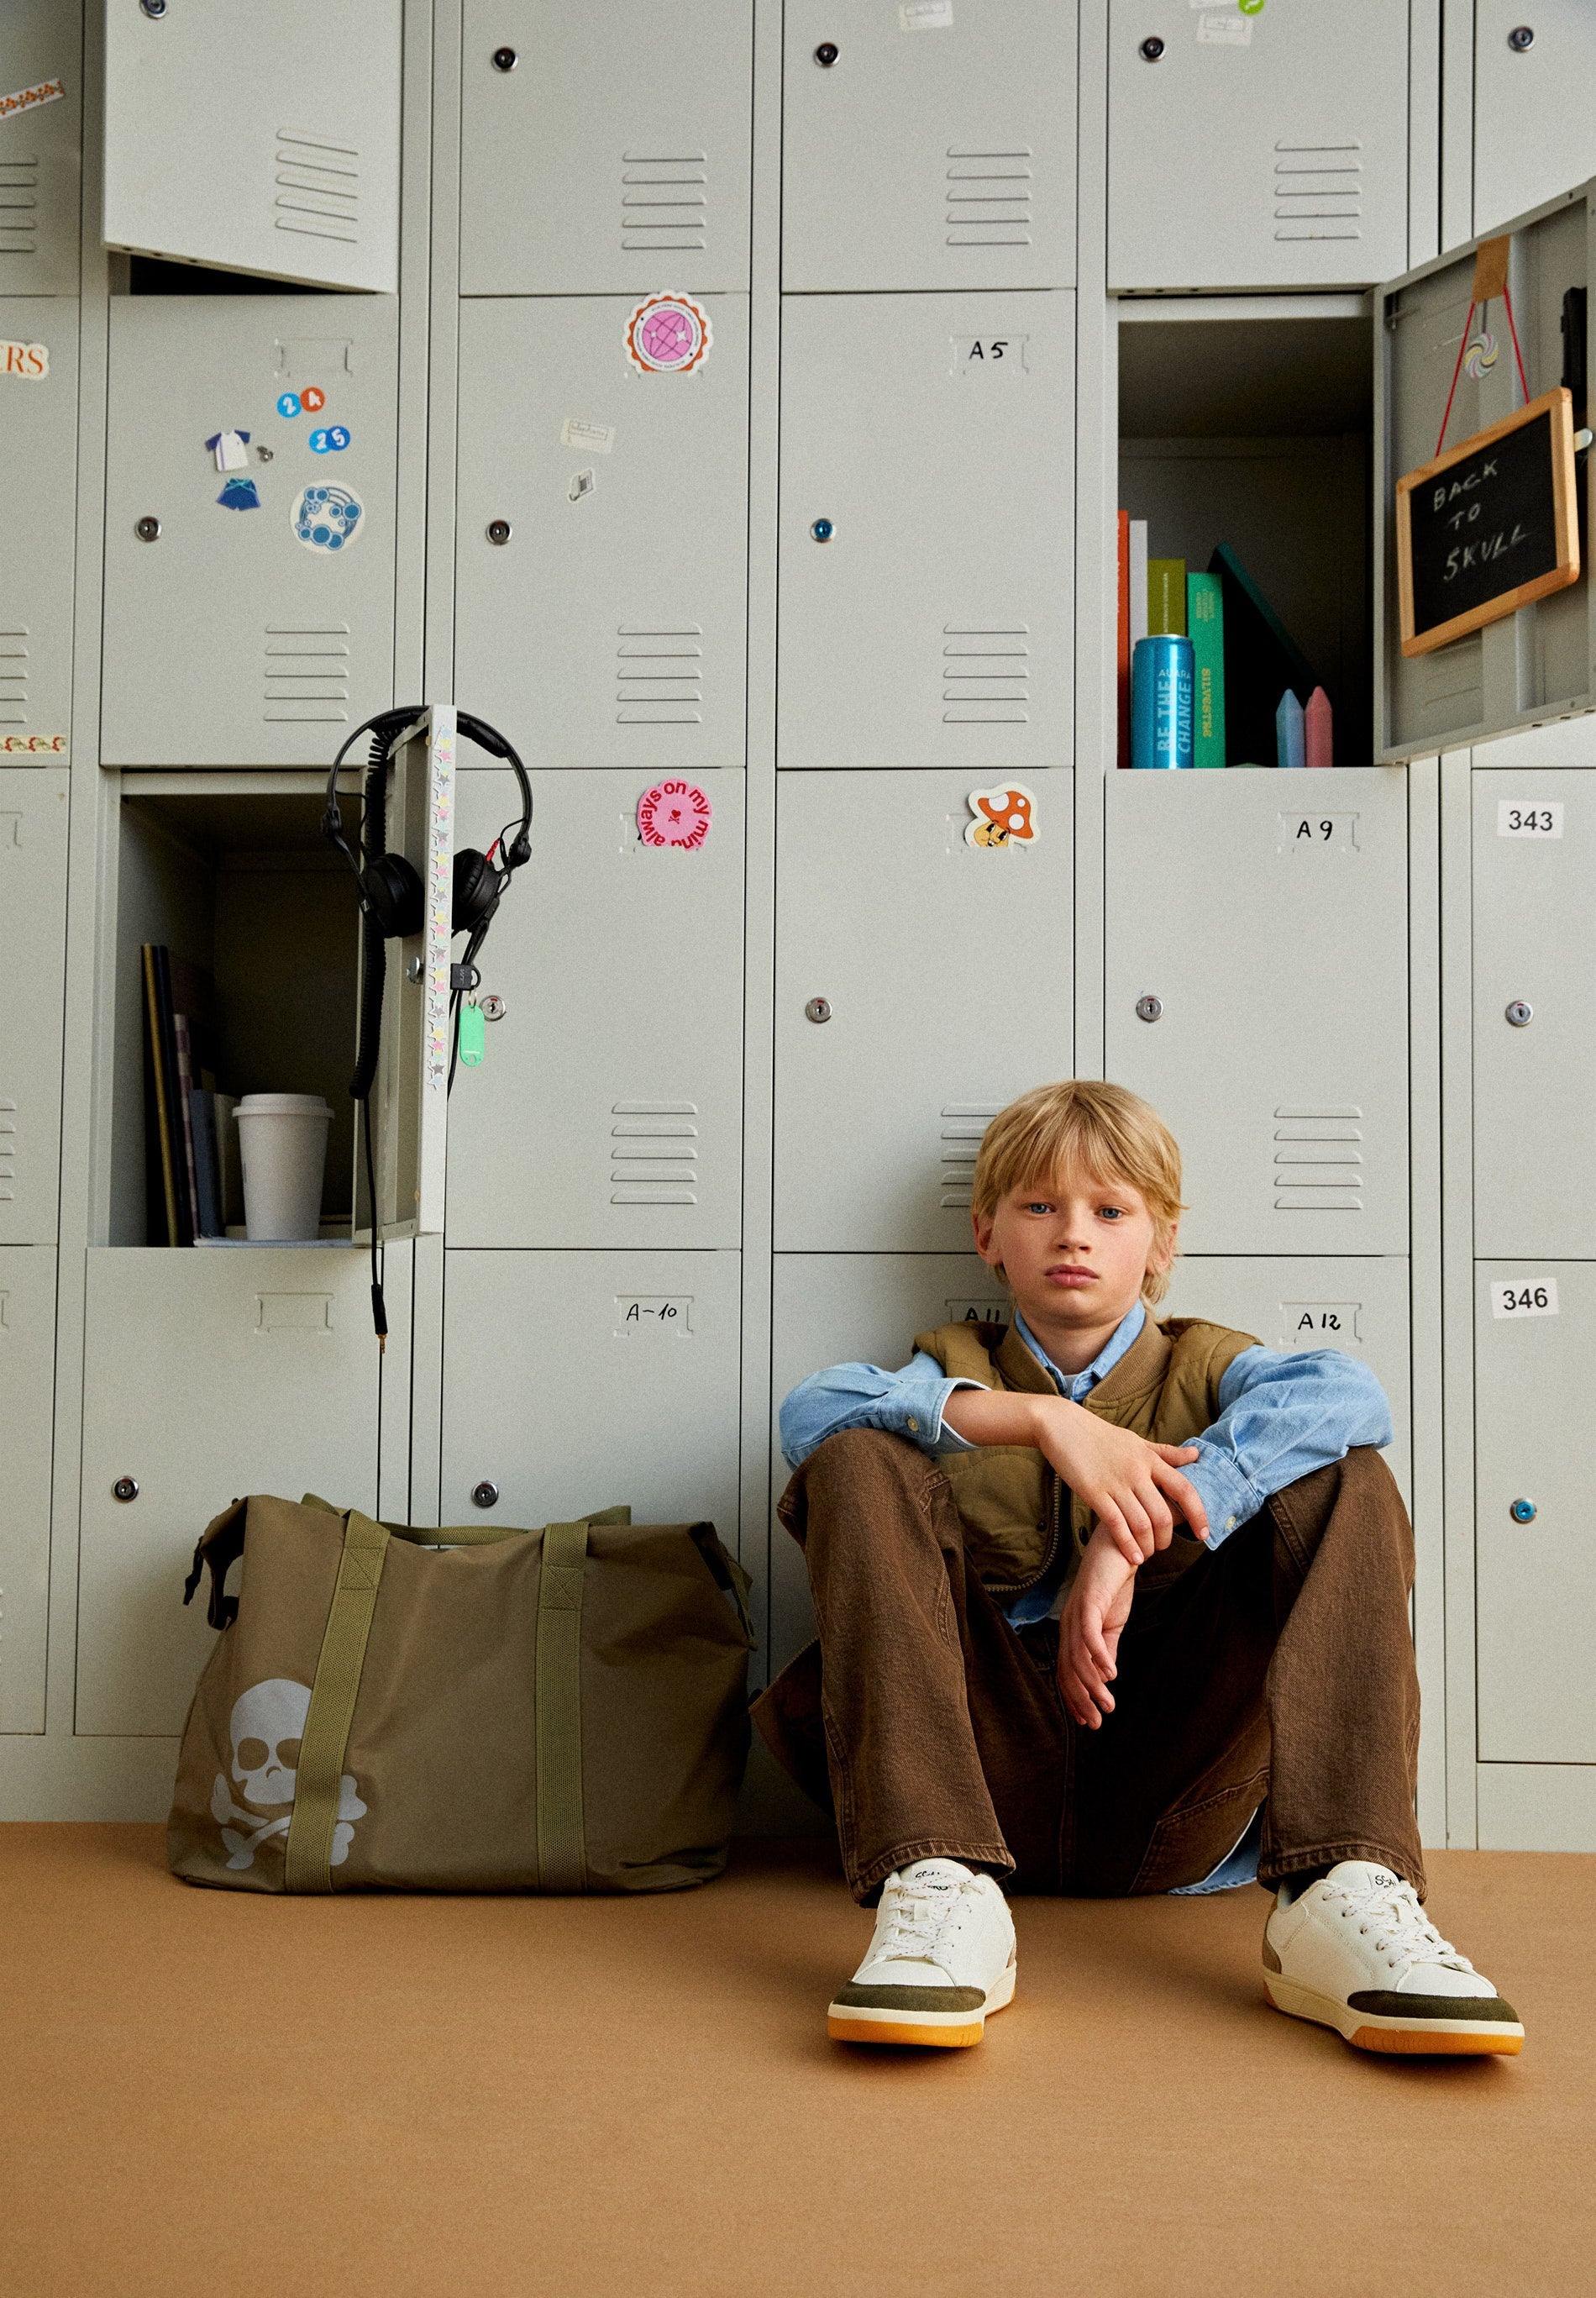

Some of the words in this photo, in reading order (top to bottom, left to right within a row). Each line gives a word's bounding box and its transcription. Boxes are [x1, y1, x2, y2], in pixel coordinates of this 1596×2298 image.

[0, 344, 43, 376] RS
[1433, 459, 1498, 513] BACK
[1446, 503, 1481, 530] TO
[1158, 681, 1174, 718] THE
[1178, 681, 1191, 753] CHANGE
[1158, 726, 1174, 751] BE
[641, 790, 665, 846] always
[664, 782, 686, 795] on
[689, 789, 710, 814] my
[1509, 810, 1553, 831] 343
[626, 1303, 677, 1321] A-10
[1502, 1287, 1548, 1310] 346
